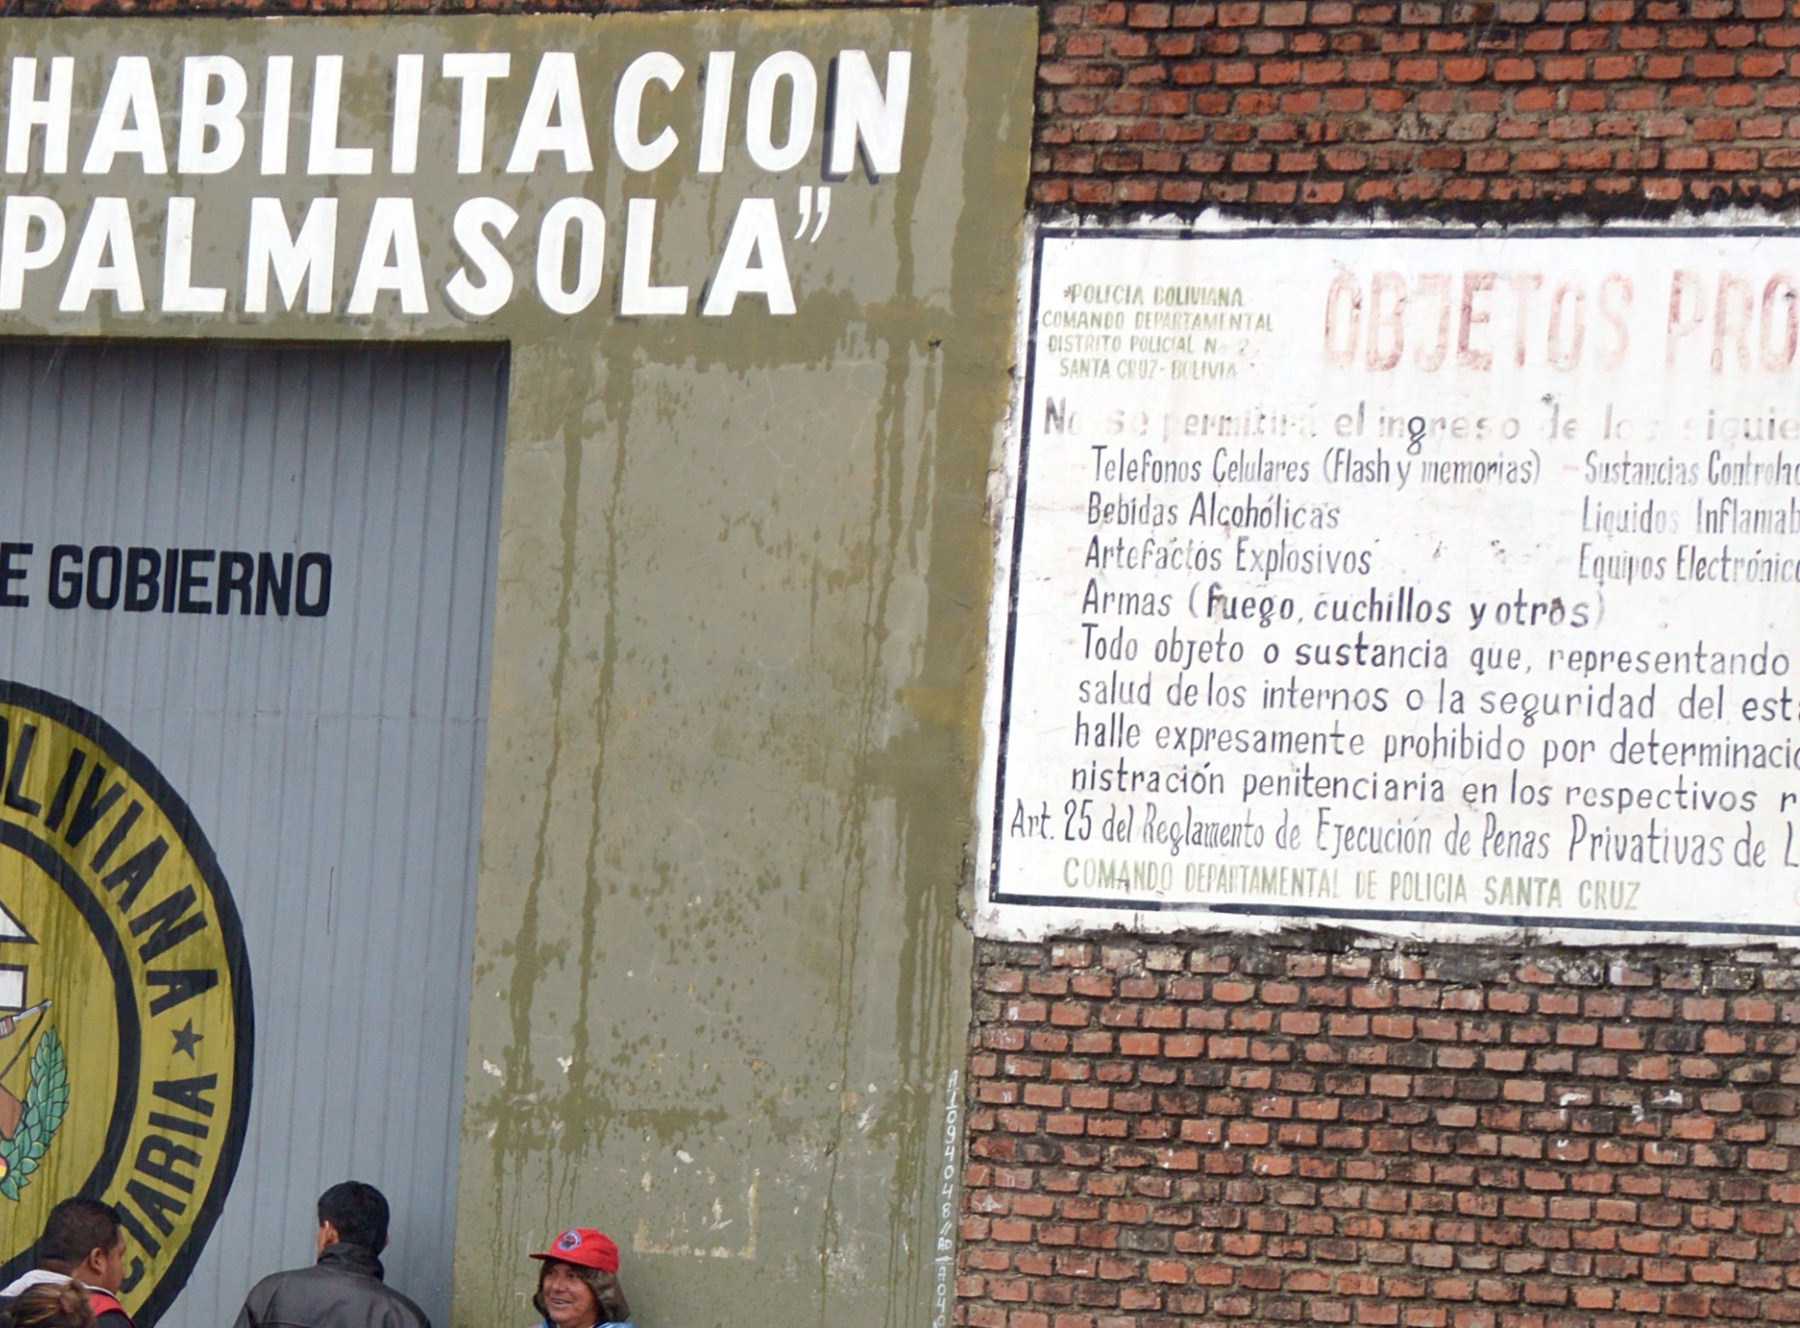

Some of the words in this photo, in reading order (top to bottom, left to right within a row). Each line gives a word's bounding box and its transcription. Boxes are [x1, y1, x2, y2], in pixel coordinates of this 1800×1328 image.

[1042, 310, 1124, 329] COMANDO
[1135, 311, 1273, 332] DEPARTAMENTAL
[1071, 284, 1143, 305] POLICIA
[1154, 286, 1243, 307] BOLIVIANA
[1323, 262, 1634, 373] OBJETOS
[1049, 335, 1121, 353] DISTRITO
[1130, 334, 1193, 353] POLICIAL
[1060, 358, 1110, 378] SANTA
[1334, 400, 1365, 437] el
[1092, 445, 1202, 483] Telefonos
[1213, 448, 1309, 483] Celulares
[1323, 446, 1389, 483] (Flash
[1396, 461, 1412, 491] y
[1421, 449, 1541, 485] memorias)
[1585, 449, 1698, 485] Sustancias
[1088, 491, 1178, 526] Bebidas
[47, 544, 332, 617] GOBIERNO
[1085, 535, 1222, 572] Artefactos
[1236, 535, 1372, 581] Explosivos
[1578, 541, 1666, 585] Equipos
[1082, 578, 1172, 616] Armas
[1314, 587, 1452, 624] cuchillos
[1470, 603, 1486, 630] y
[1082, 623, 1138, 661] Todo
[1154, 627, 1244, 670] objeto
[1264, 641, 1279, 663] o
[1296, 632, 1448, 669] sustancia
[1470, 646, 1533, 675] que,
[1549, 640, 1789, 677] representando
[1079, 670, 1152, 705] salud
[1167, 673, 1198, 706] de
[1208, 672, 1246, 707] los
[1263, 676, 1388, 712] internos
[1406, 689, 1423, 712] o
[1438, 678, 1464, 714] la
[1480, 683, 1655, 727] seguridad
[1678, 684, 1724, 720] del
[1075, 711, 1140, 748] halle
[1156, 720, 1365, 761] expresamente
[1384, 721, 1524, 763] prohibido
[1543, 739, 1596, 768] por
[1072, 756, 1225, 795] nistración
[1243, 761, 1444, 803] penitenciaria
[1463, 781, 1497, 804] en
[1511, 768, 1553, 806] los
[1566, 774, 1757, 815] respectivos
[1011, 798, 1055, 841] Art.
[1064, 799, 1093, 842] 25
[1102, 803, 1134, 843] del
[1143, 802, 1264, 857] Reglamento
[1276, 808, 1300, 851] de
[1317, 807, 1431, 859] Ejecución
[1445, 814, 1471, 856] de
[1483, 812, 1550, 860] Penas
[1569, 814, 1724, 866] Privativas
[1735, 820, 1766, 868] de
[1063, 857, 1172, 891] COMANDO
[1185, 862, 1340, 899] DEPARTAMENTAL
[1356, 870, 1377, 900] DE
[1391, 870, 1467, 904] POLICIA
[1485, 875, 1562, 908] SANTA
[1579, 880, 1641, 910] CRUZ
